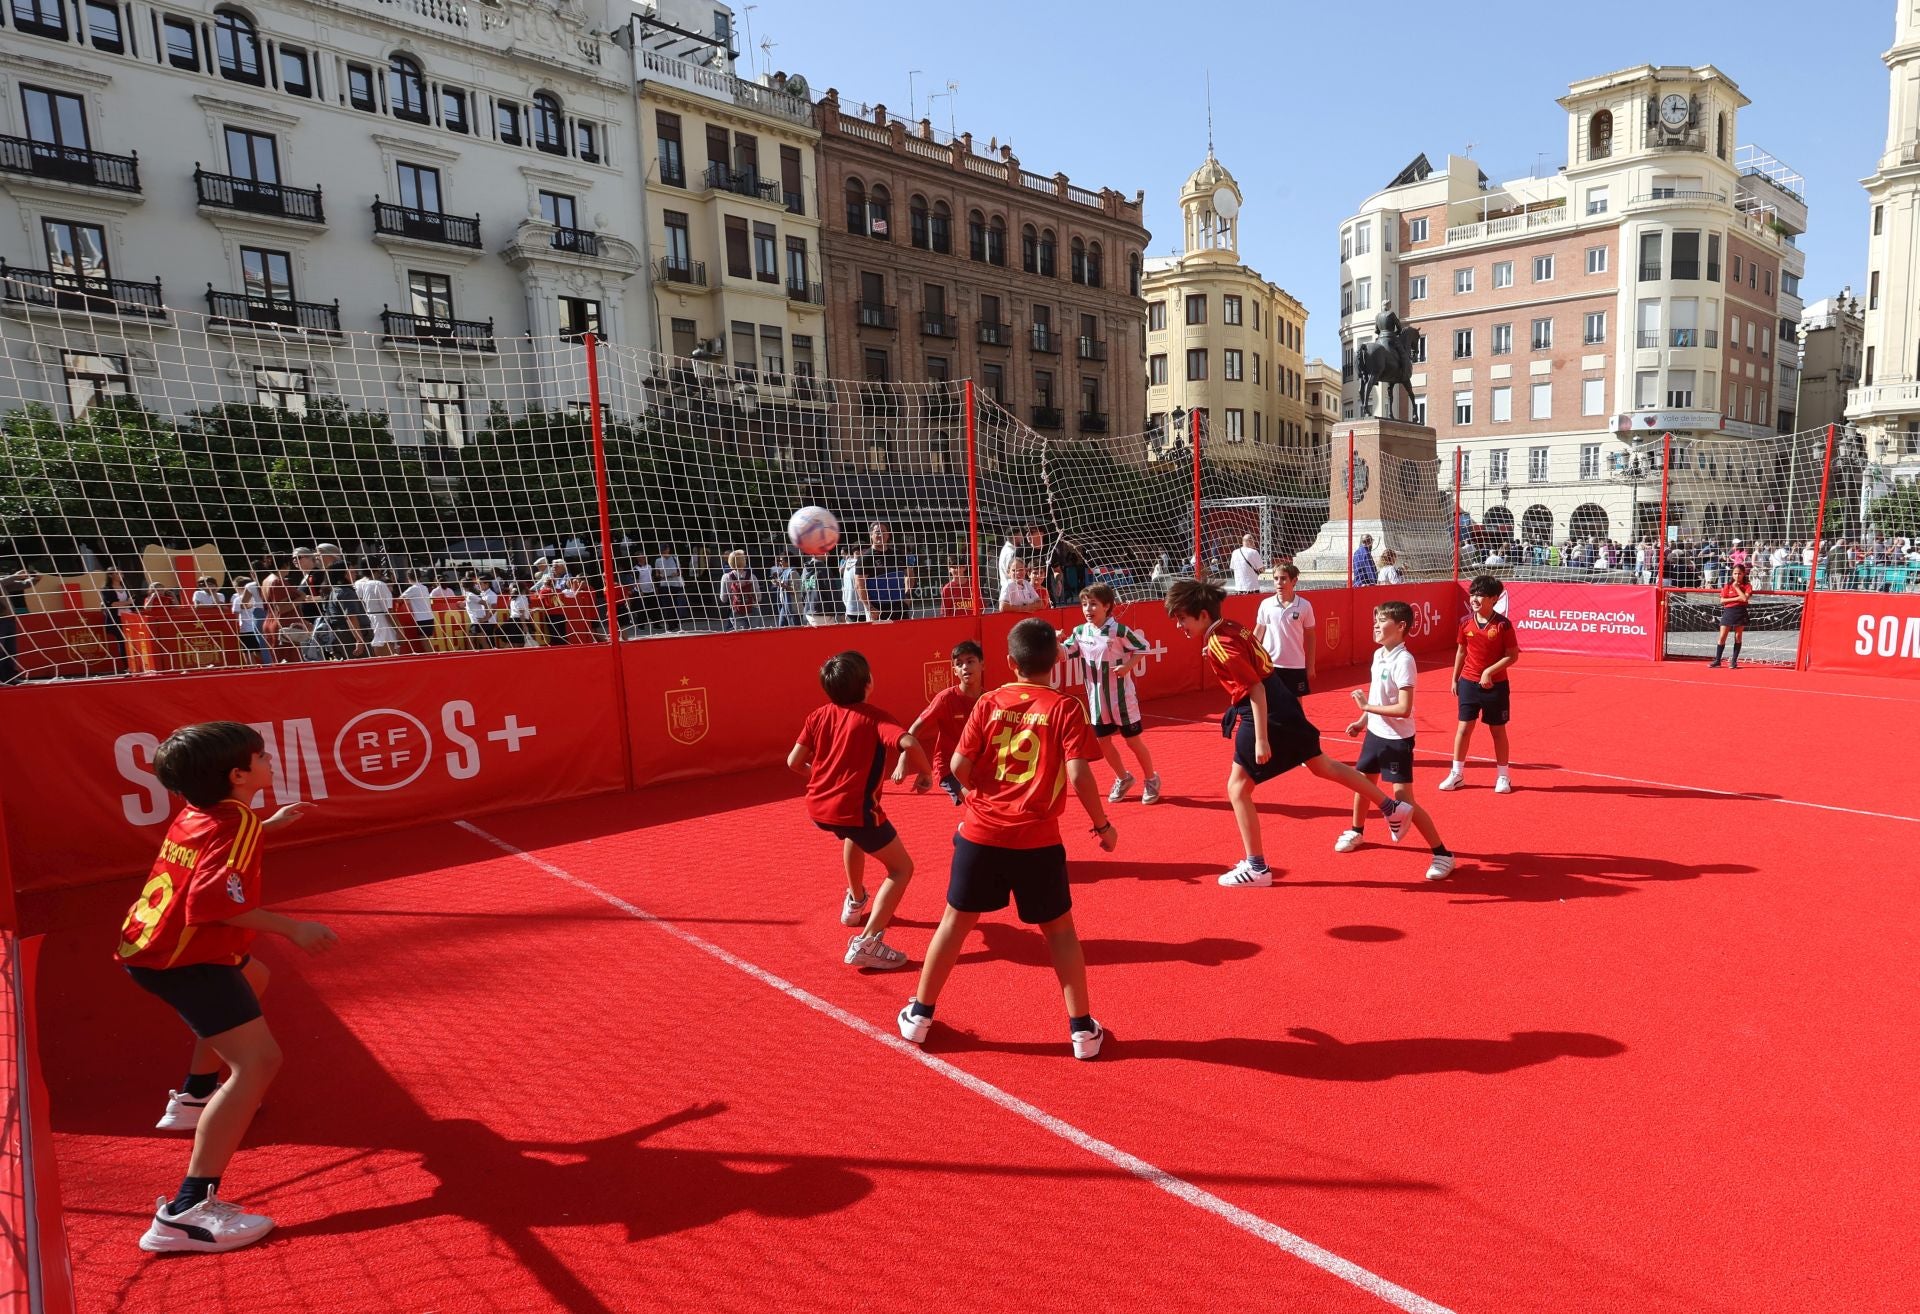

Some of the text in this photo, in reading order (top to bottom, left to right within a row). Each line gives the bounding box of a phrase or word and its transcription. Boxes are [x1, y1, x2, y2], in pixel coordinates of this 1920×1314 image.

[1528, 609, 1635, 622] REAL FEDERACIÓN
[1517, 620, 1647, 636] ANDALUZA DE FÚTBOL
[991, 709, 1050, 726] LAMINE YAMAL
[991, 726, 1041, 784] 19
[118, 872, 174, 958] 9
